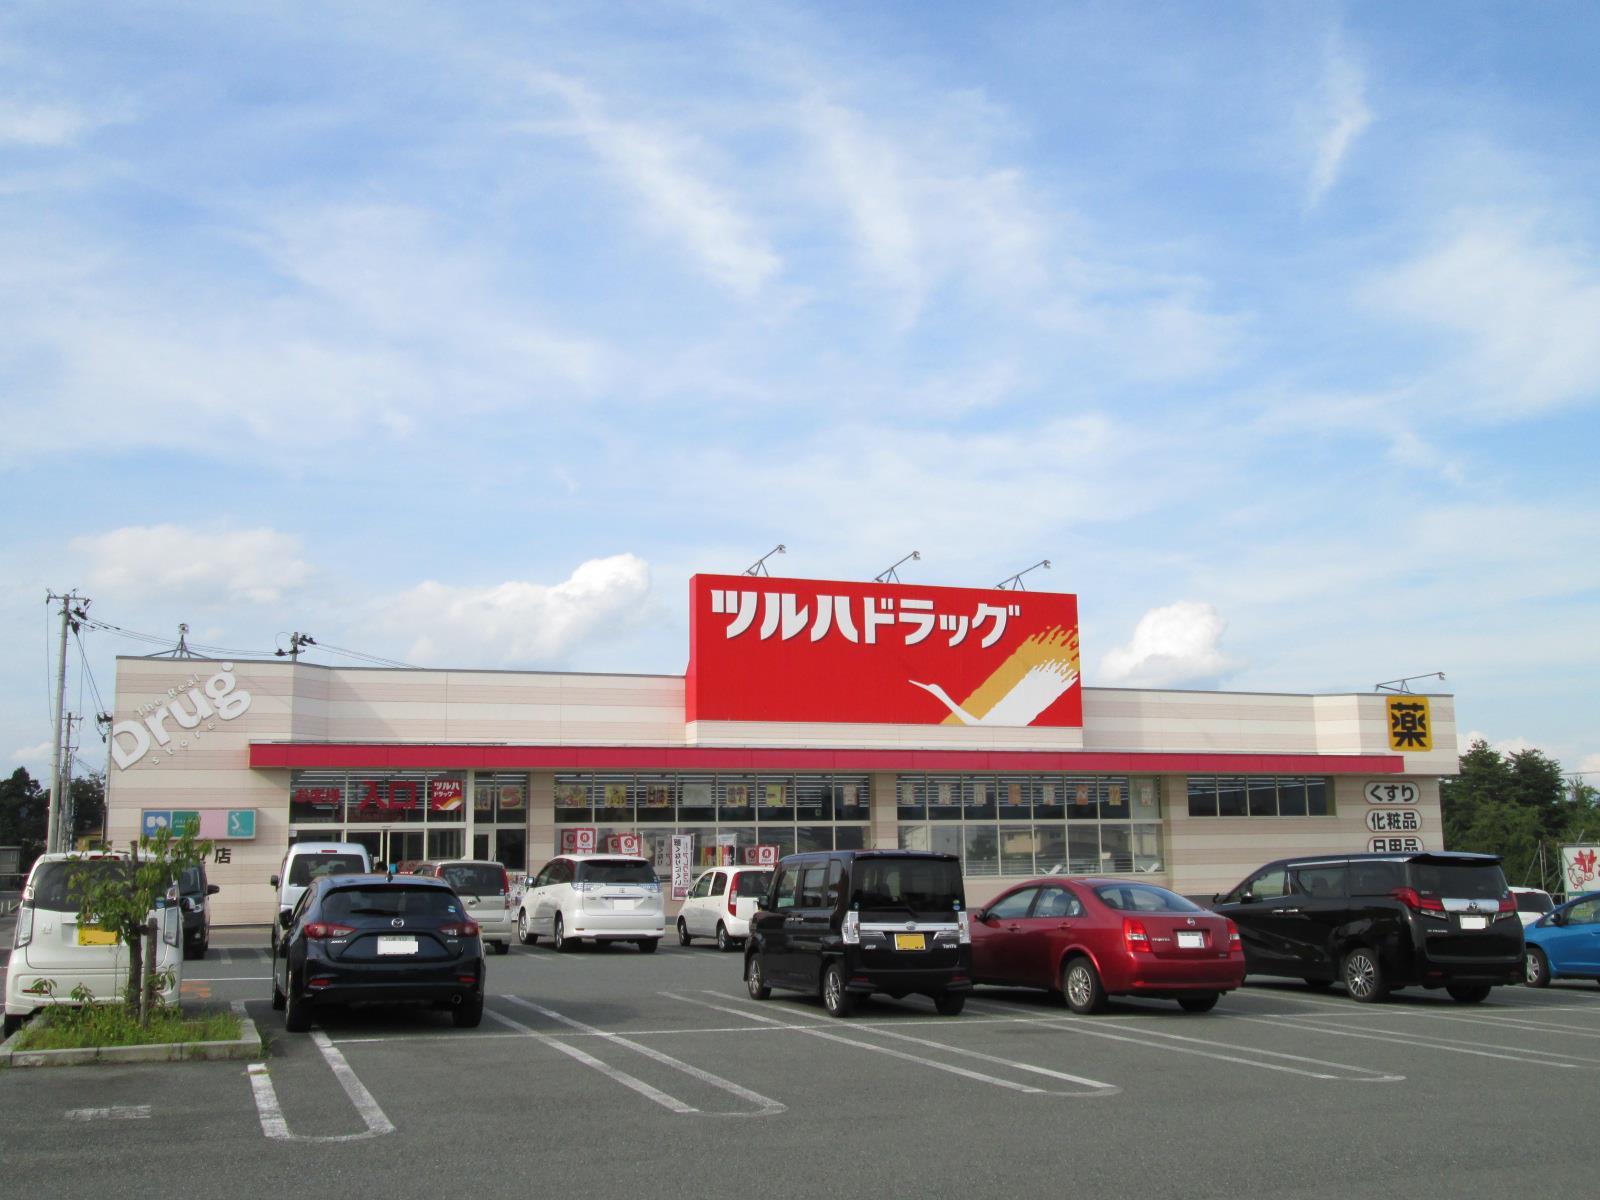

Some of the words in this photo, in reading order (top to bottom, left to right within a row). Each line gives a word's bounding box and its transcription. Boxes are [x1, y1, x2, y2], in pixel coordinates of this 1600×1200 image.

[711, 589, 1021, 649] ツルハドラッグ
[135, 699, 162, 717] The
[167, 672, 201, 697] Real
[111, 662, 251, 771] Drug
[1391, 702, 1427, 747] 薬
[360, 779, 416, 809] 入口
[434, 781, 460, 791] ツルハ
[1370, 784, 1414, 802] くすり
[1371, 812, 1417, 830] 化粧品
